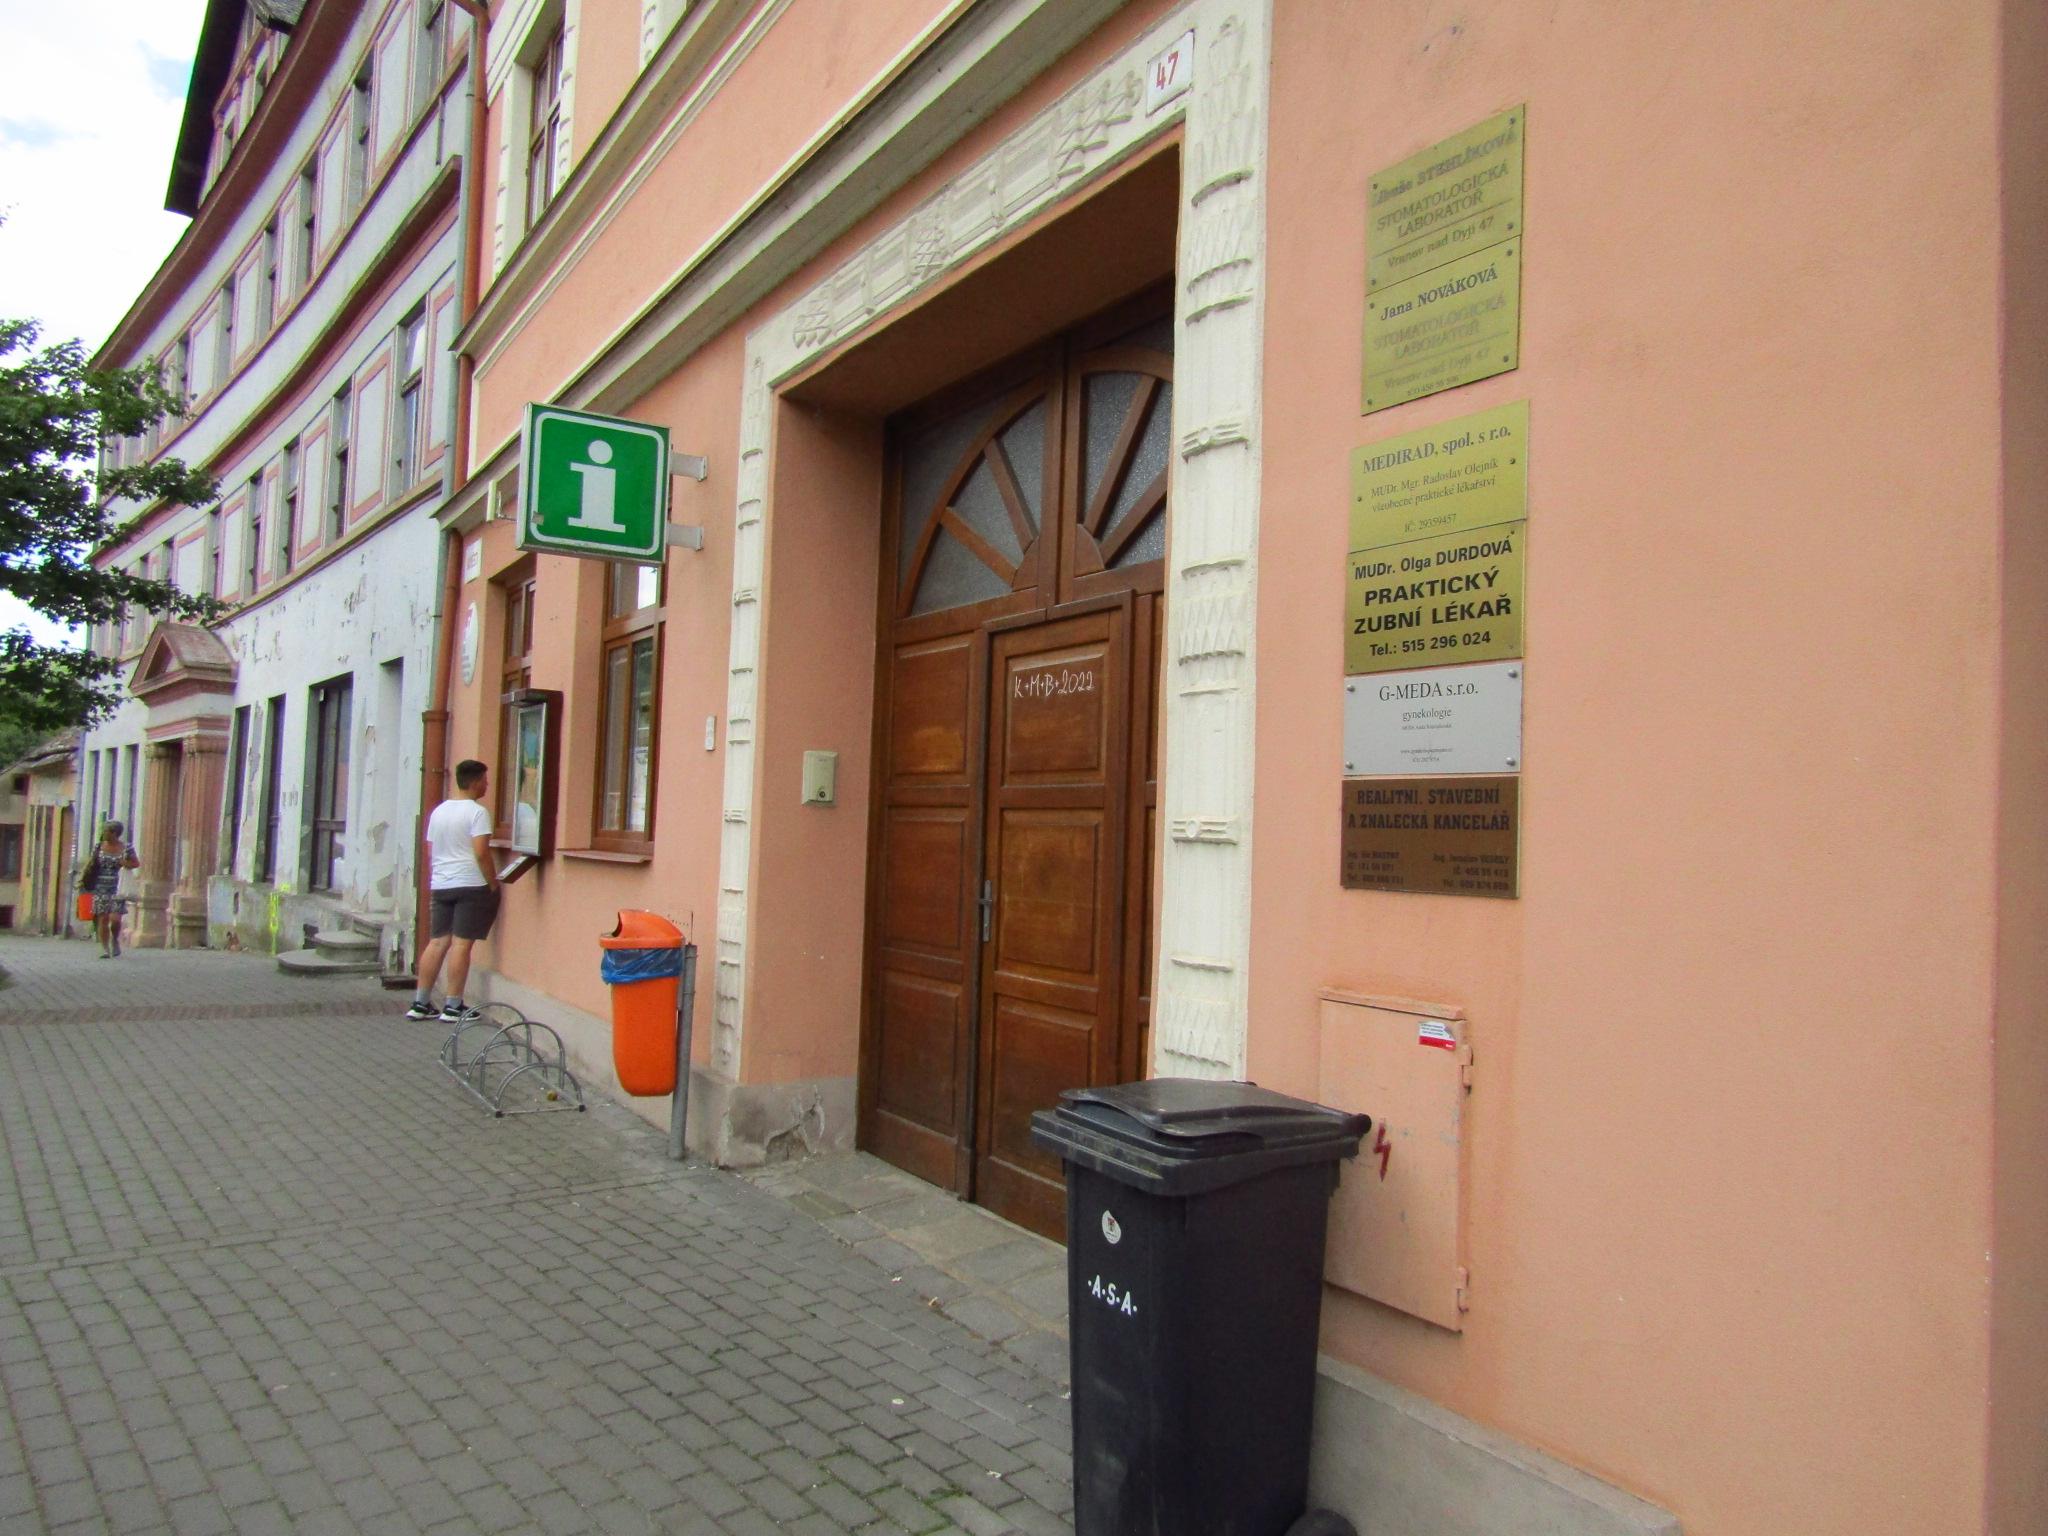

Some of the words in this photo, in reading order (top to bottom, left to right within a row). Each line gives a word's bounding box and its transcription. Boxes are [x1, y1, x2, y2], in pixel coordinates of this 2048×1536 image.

[1156, 51, 1178, 90] 47
[1376, 159, 1508, 232] STOMATOLOGICKÁ
[1397, 188, 1484, 239] LABORATOŘ
[1428, 237, 1449, 256] nad
[1478, 215, 1495, 232] 47
[1380, 300, 1413, 322] Jana
[1417, 263, 1498, 307] NOVÁKOVÁ
[1363, 441, 1439, 474] MEDIRAD,
[1442, 432, 1474, 455] spol.
[1478, 432, 1486, 443] s
[1489, 425, 1511, 441] r.o.
[568, 440, 626, 533] i
[1371, 483, 1398, 498] MUDr.
[1401, 477, 1421, 493] Mgr.
[1423, 467, 1463, 487] Radoslav
[1464, 458, 1499, 477] Olejník
[1415, 485, 1454, 506] praktické
[1456, 475, 1496, 494] lékařství
[1354, 562, 1396, 580] MUDr.
[1400, 556, 1431, 573] Olga
[1435, 536, 1512, 567] DURDOVÁ
[1364, 565, 1500, 606] PRAKTICKÝ
[1353, 606, 1421, 635] ZUBNÍ
[1431, 593, 1512, 625] LÉKAŘ
[1369, 643, 1397, 656] Tel.:
[1402, 639, 1425, 653] 515
[1430, 636, 1457, 650] 296
[1462, 631, 1491, 646] 024
[1379, 682, 1442, 702] G-MEDA
[1446, 683, 1479, 696] s.r.o.
[1402, 707, 1452, 722] gynekologie
[1428, 783, 1500, 805] STAVEBNÍ
[1348, 813, 1356, 829] A
[1360, 810, 1428, 830] ZNALECKÁ
[1433, 809, 1510, 831] KANCELÁŘ
